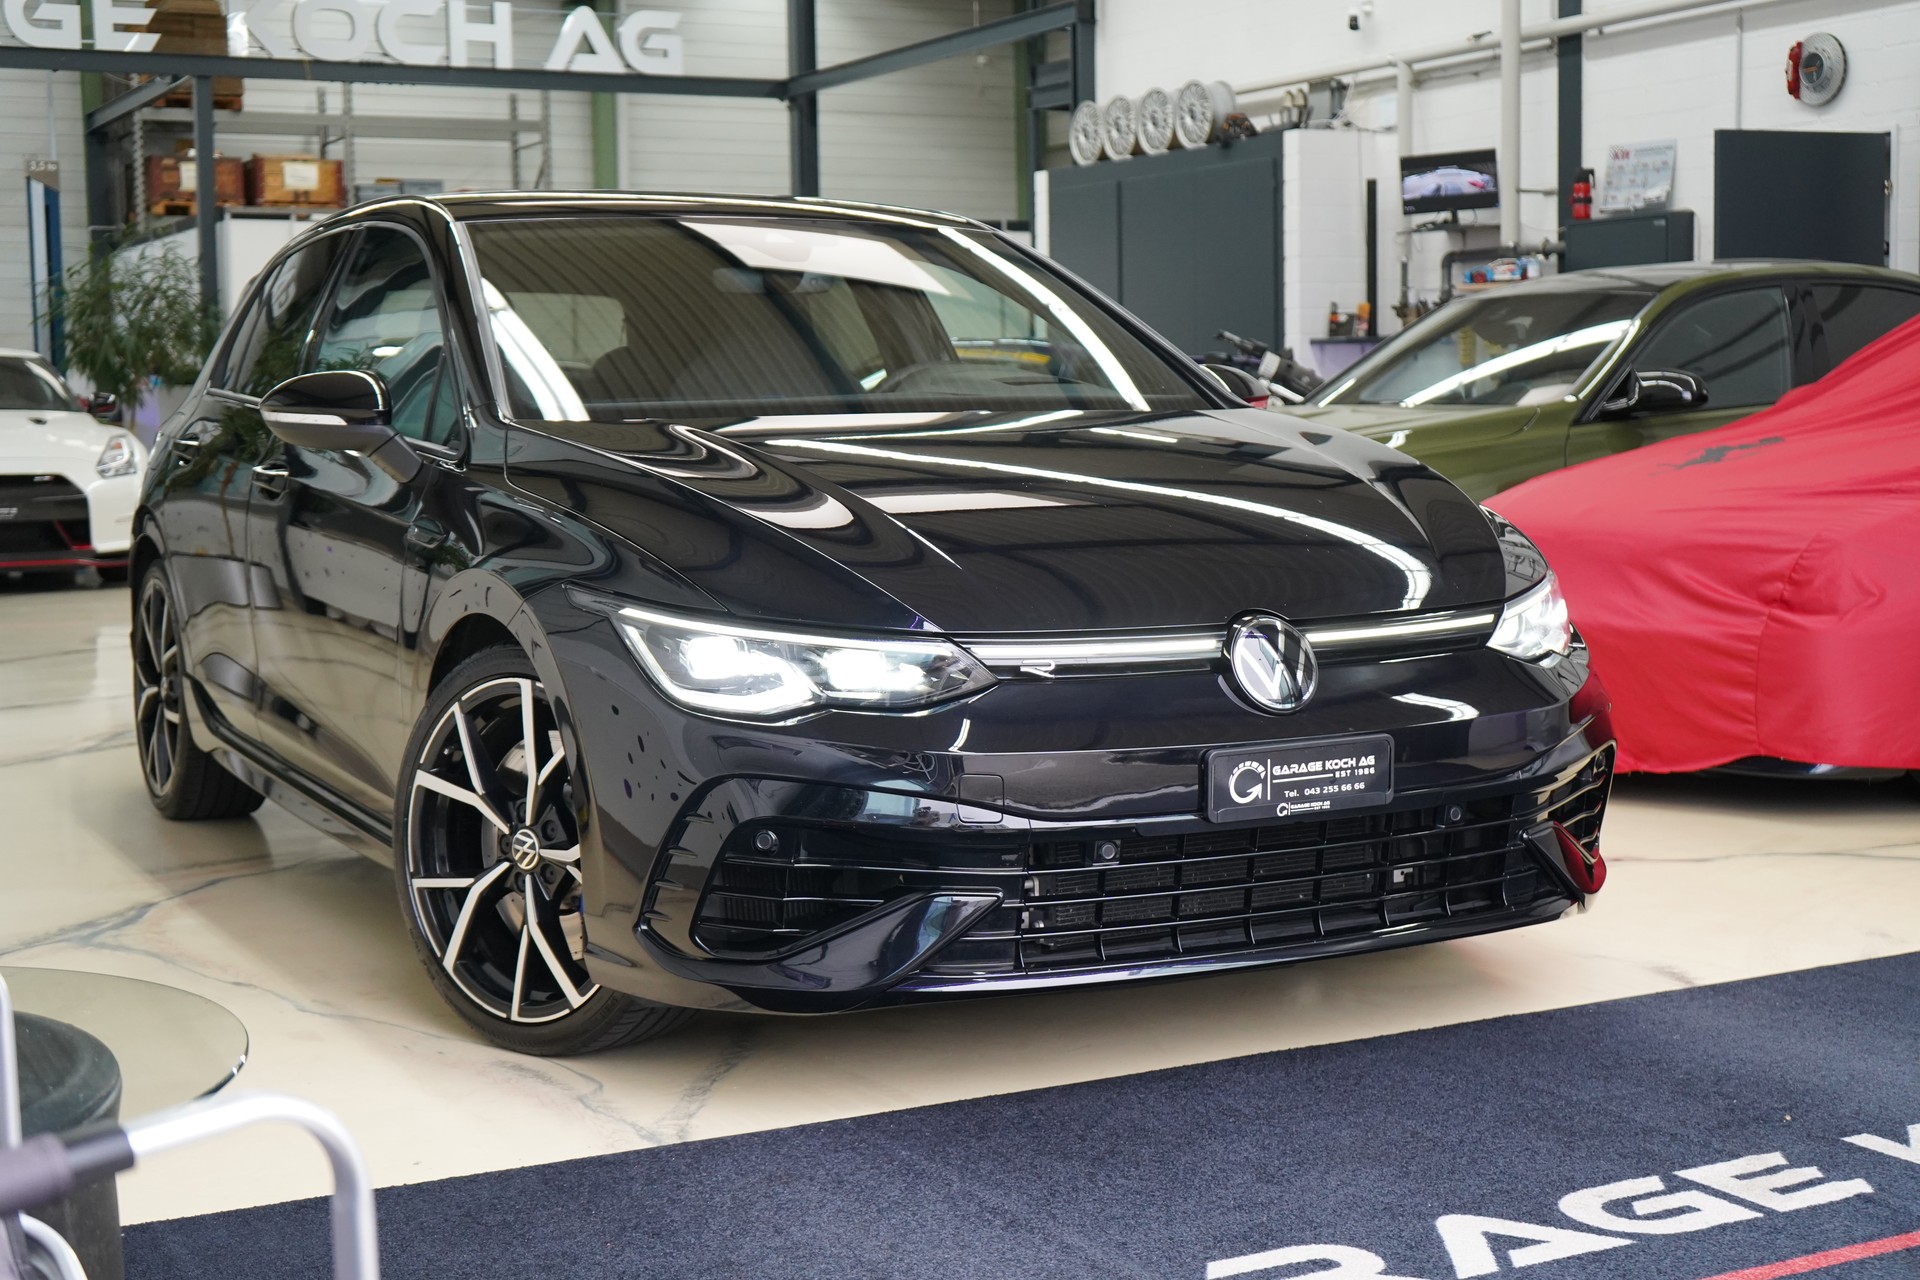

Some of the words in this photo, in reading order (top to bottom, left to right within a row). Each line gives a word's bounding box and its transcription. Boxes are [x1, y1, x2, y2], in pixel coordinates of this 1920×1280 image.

[226, 0, 512, 68] KOCH
[544, 5, 683, 75] AG
[1272, 761, 1323, 776] GARAGE
[1325, 757, 1356, 770] KOCH
[1358, 755, 1375, 767] AG
[1335, 770, 1351, 778] EST
[1354, 767, 1375, 776] 1986
[1284, 789, 1299, 798] Tel.
[1304, 787, 1320, 796] 043
[1322, 785, 1338, 793] 255
[1341, 783, 1352, 791] 66
